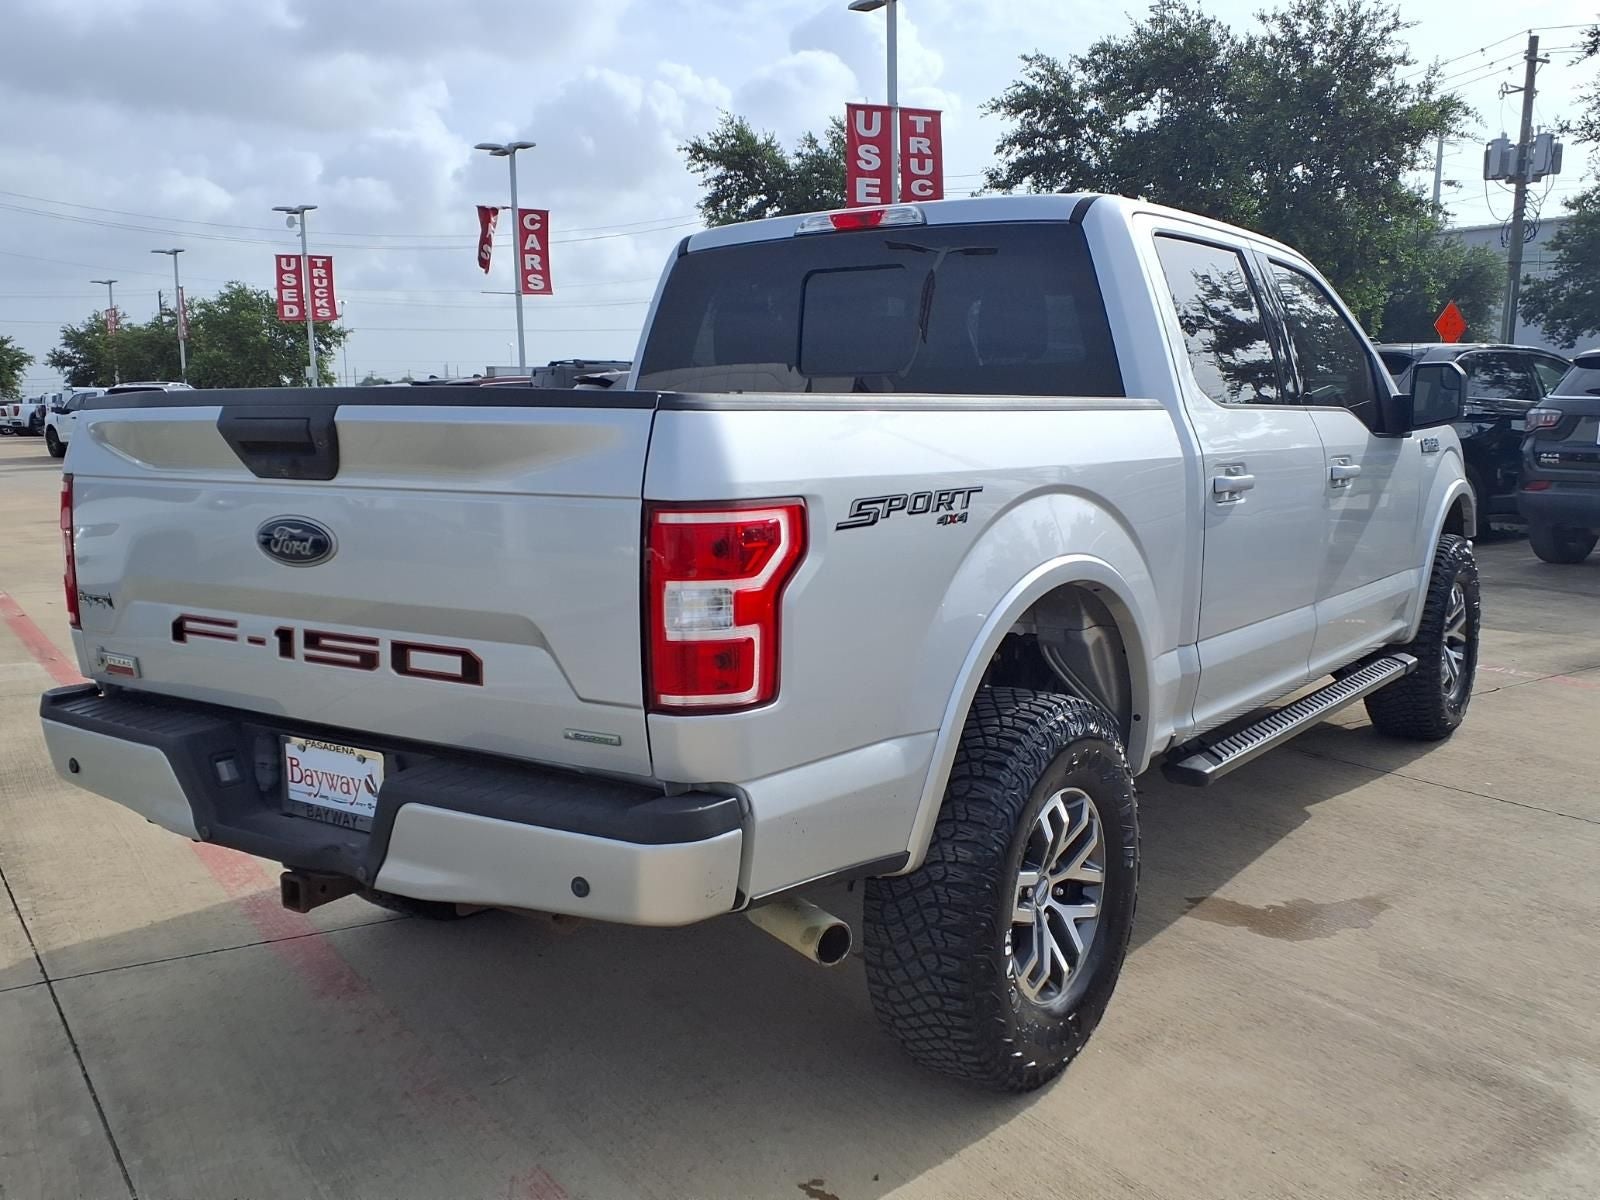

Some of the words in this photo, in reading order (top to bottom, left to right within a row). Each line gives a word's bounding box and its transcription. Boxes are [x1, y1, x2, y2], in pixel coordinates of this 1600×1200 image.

[855, 110, 881, 203] USE
[908, 115, 934, 203] TRUC
[523, 213, 545, 290] CARS
[280, 257, 299, 317] USED
[312, 258, 331, 317] TRUCKS
[835, 486, 983, 531] SPORT
[270, 525, 314, 556] Ford
[171, 613, 484, 687] F-150
[305, 740, 355, 756] PASADENA
[287, 756, 362, 806] Bayway
[306, 806, 358, 828] BAYWAY
